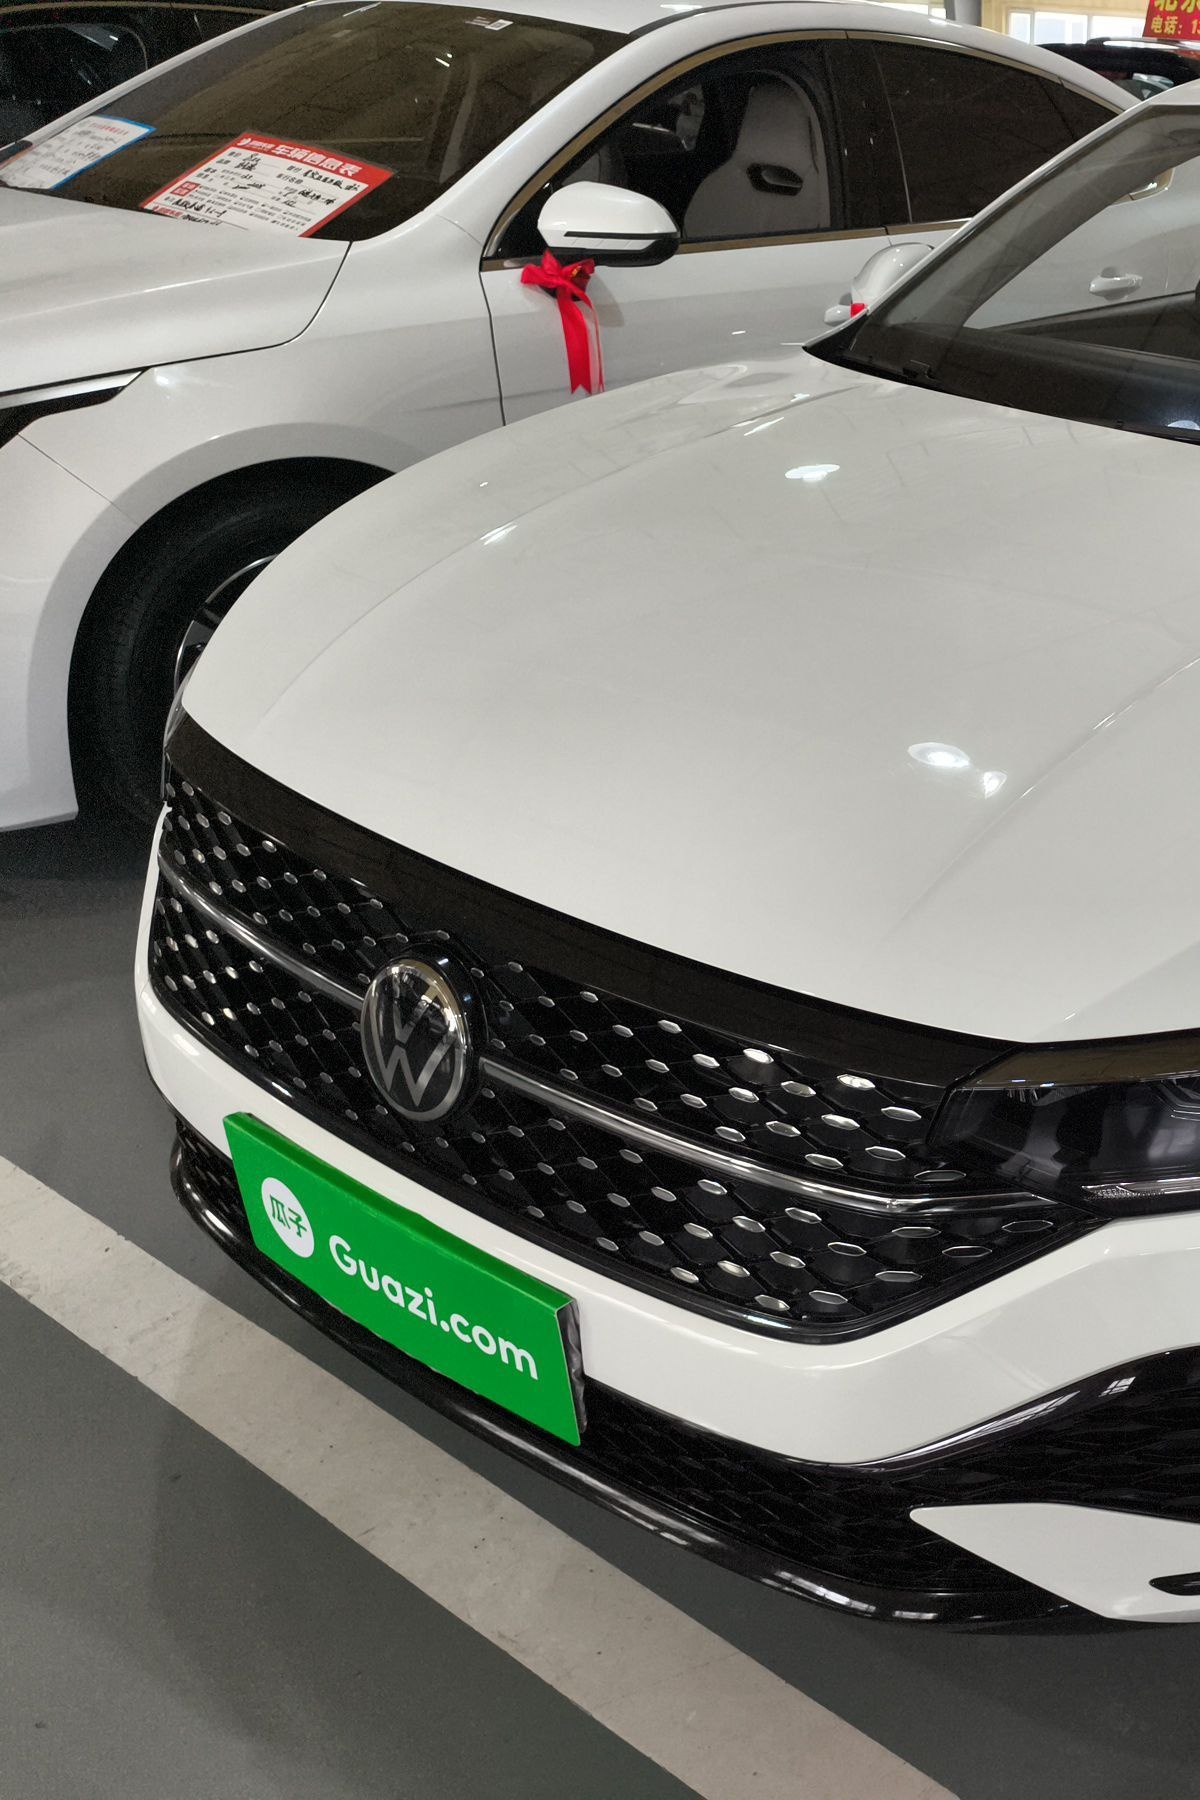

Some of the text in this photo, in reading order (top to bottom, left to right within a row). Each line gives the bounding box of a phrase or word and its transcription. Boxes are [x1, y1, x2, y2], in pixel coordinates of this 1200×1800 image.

[1151, 15, 1183, 35] 电话：
[271, 144, 364, 178] 车辆信息表
[269, 1194, 308, 1238] 瓜子
[328, 1234, 539, 1381] Guazi.com
